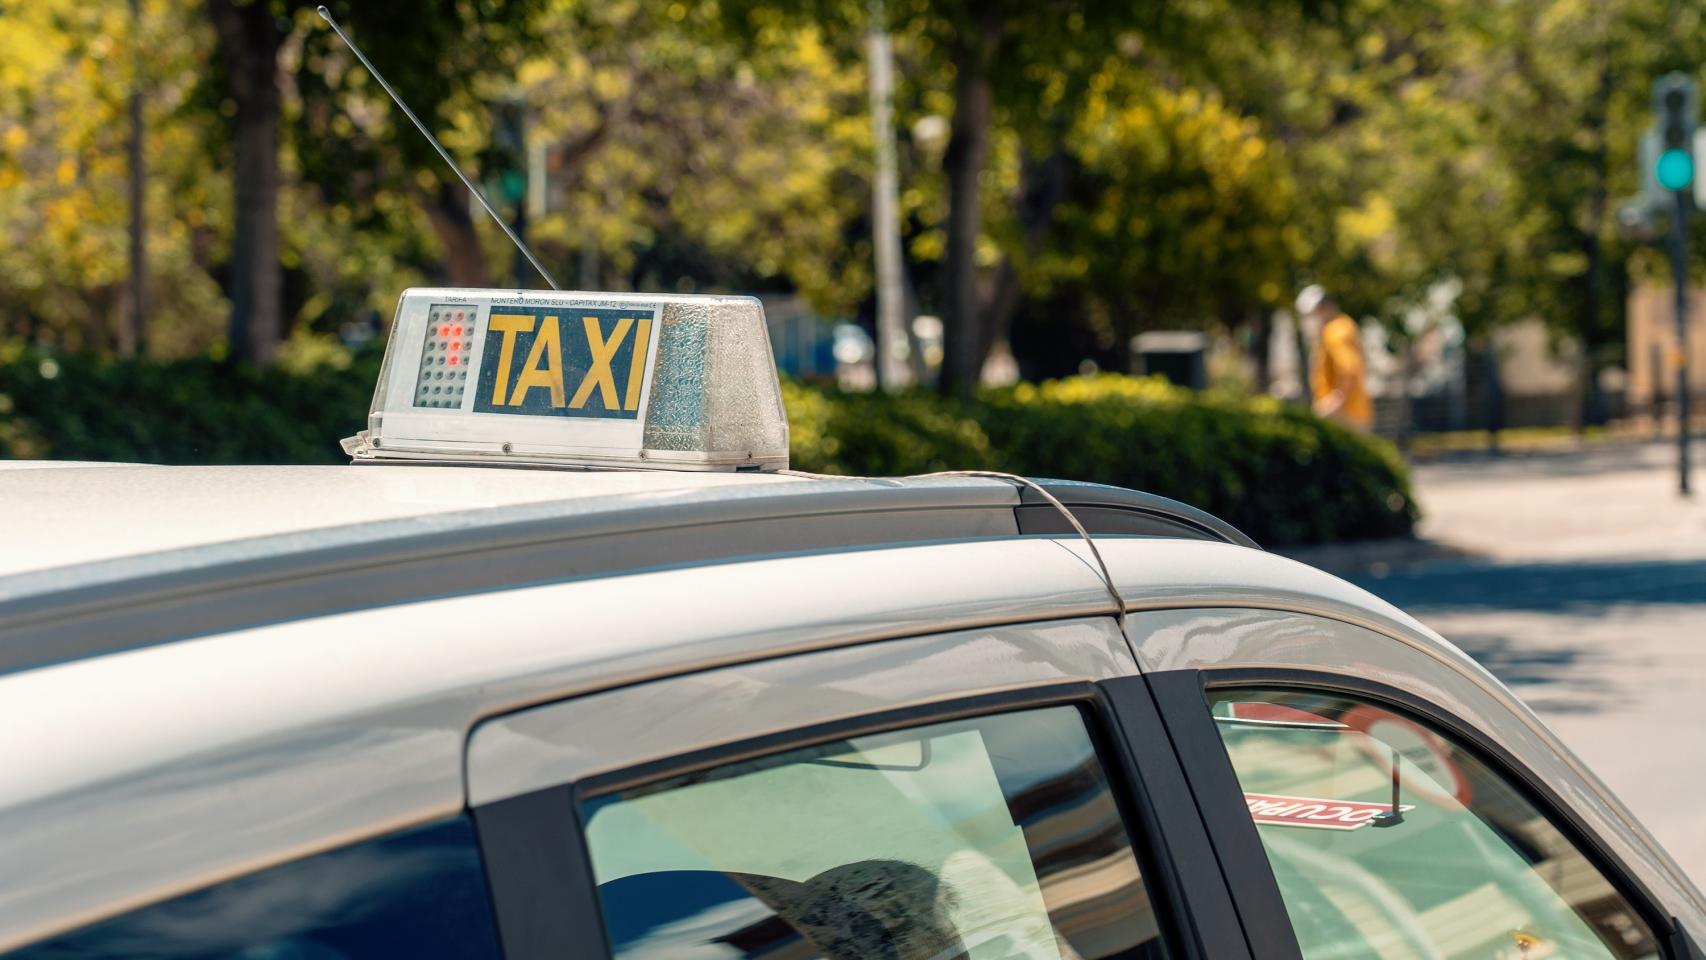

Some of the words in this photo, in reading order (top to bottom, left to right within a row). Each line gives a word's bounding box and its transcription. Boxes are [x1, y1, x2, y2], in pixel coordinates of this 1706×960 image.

[490, 297, 523, 305] MONTERO
[570, 299, 597, 307] CAPITAX
[598, 300, 617, 308] JM-12
[488, 314, 652, 410] TAXI
